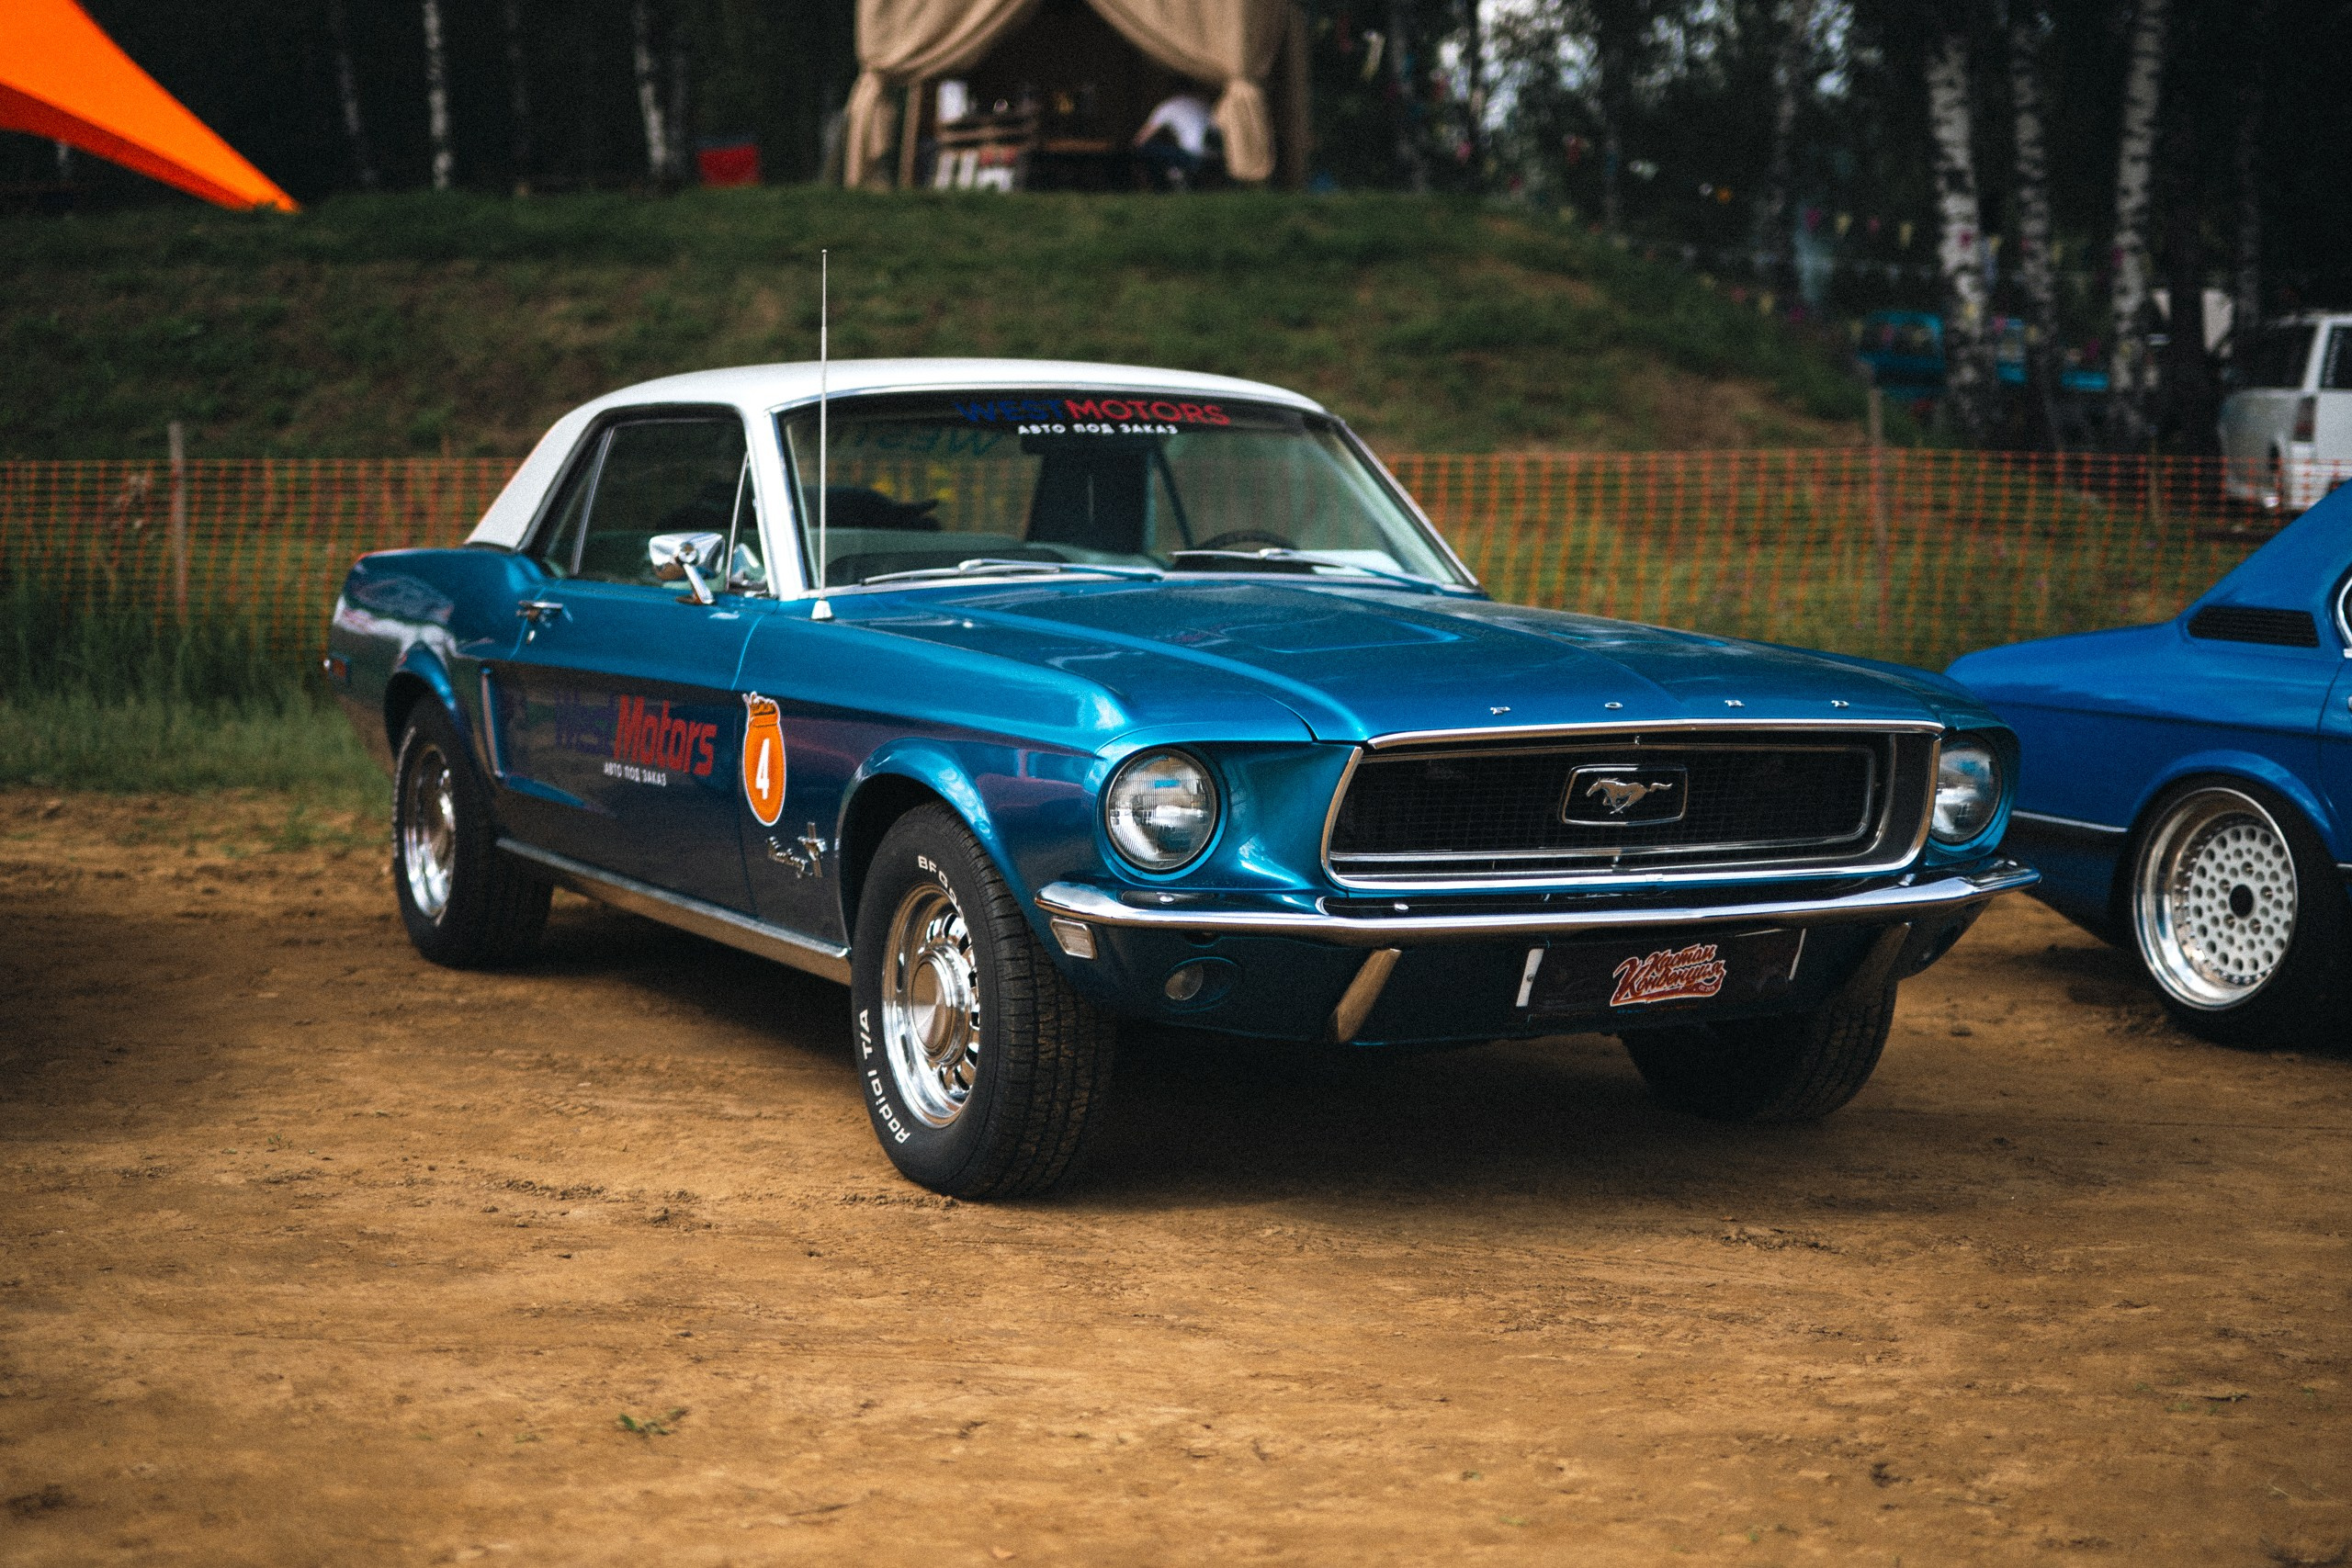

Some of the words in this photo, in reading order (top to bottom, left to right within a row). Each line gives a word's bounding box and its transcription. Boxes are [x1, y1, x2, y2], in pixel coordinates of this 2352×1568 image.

[1017, 423, 1066, 434] АВТО
[1072, 423, 1114, 434] ПОД
[1120, 423, 1179, 435] ЗАКАЗ
[604, 762, 623, 778] АВТО
[624, 765, 641, 783] ПОД
[642, 769, 666, 787] ЗАКАЗ
[755, 738, 771, 800] 4
[859, 1009, 874, 1060] T/A
[867, 1069, 911, 1145] Radial
